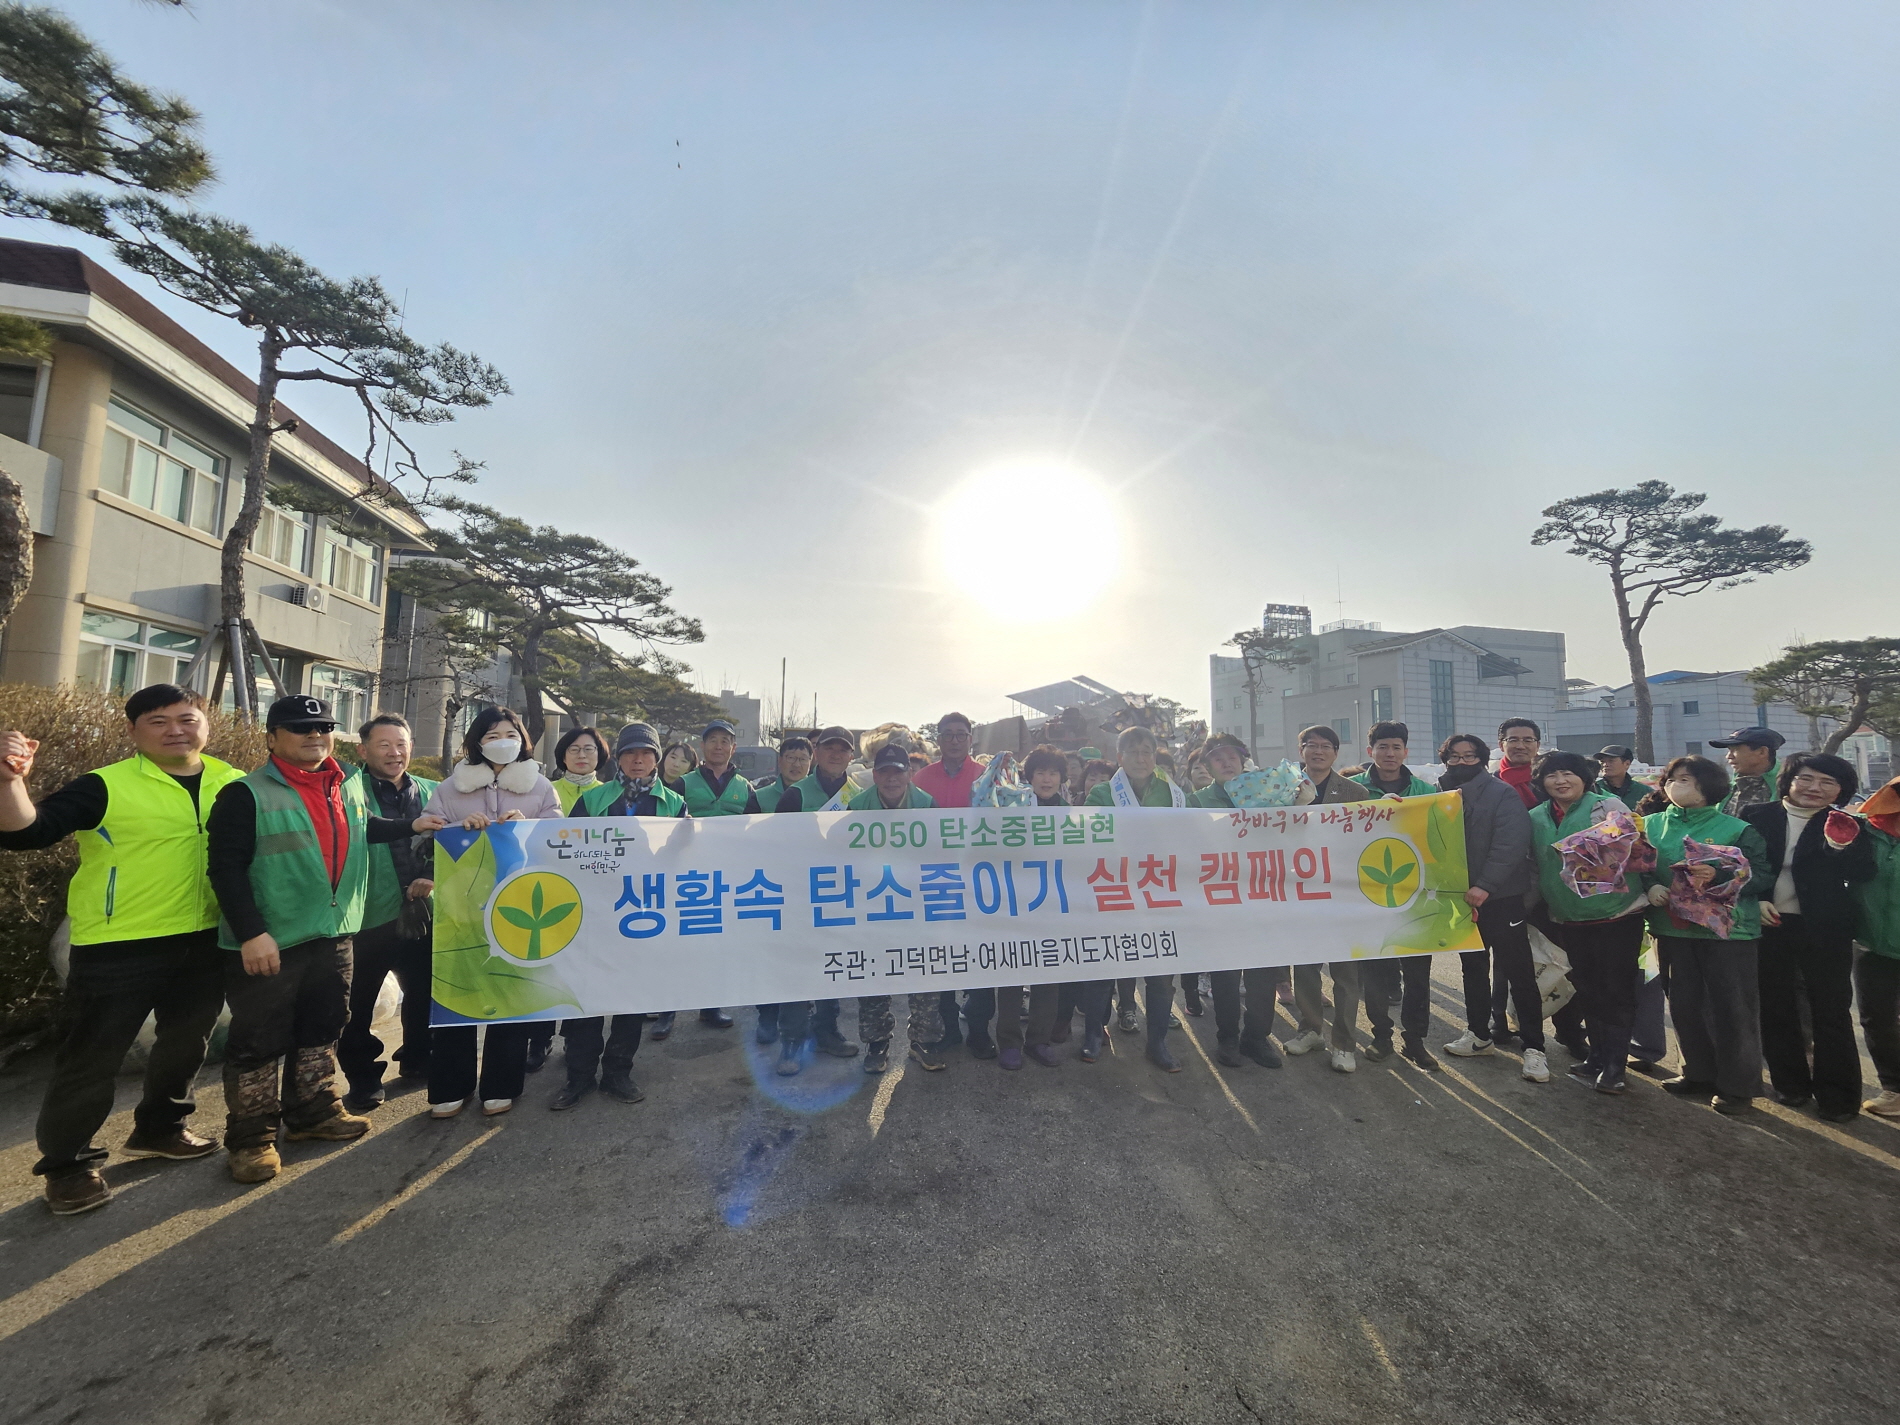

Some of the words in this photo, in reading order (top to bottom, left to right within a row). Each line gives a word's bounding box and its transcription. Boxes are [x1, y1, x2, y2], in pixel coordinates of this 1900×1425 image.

[848, 821, 928, 849] 2050
[940, 813, 1115, 850] 탄소중립실현
[1229, 808, 1309, 839] 장바구니
[1320, 803, 1396, 833] 나눔행사
[547, 827, 635, 860] 온기나눔
[573, 849, 612, 861] 하나되는
[580, 861, 621, 875] 대한민국
[614, 868, 786, 940] 생활속
[810, 858, 1070, 929] 탄소줄이기
[1088, 854, 1183, 913] 실천
[1199, 846, 1333, 907] 캠페인
[823, 950, 876, 982] 주관:
